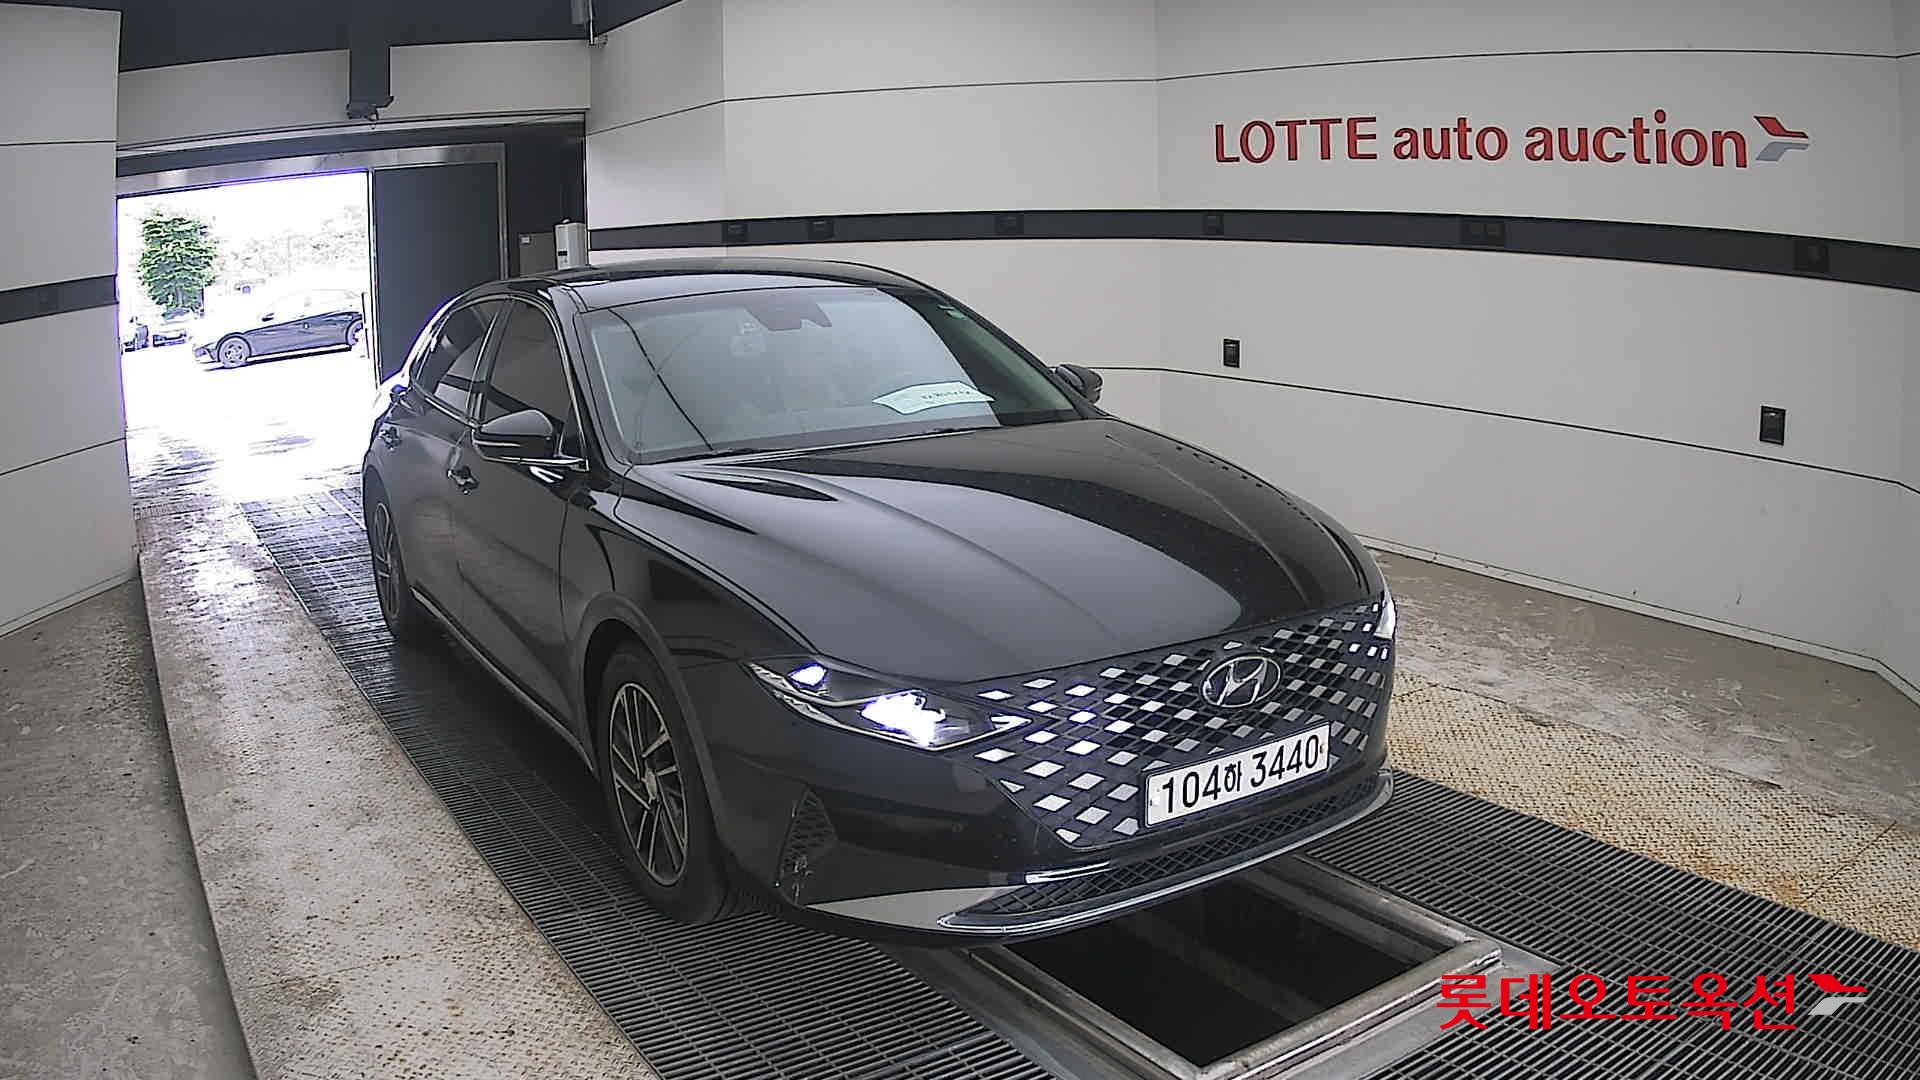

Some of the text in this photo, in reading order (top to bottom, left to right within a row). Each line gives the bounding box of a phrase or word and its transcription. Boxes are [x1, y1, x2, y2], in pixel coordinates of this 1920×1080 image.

[1214, 109, 1749, 169] LOTTE auto auction
[1161, 734, 1320, 815] 104하 3440
